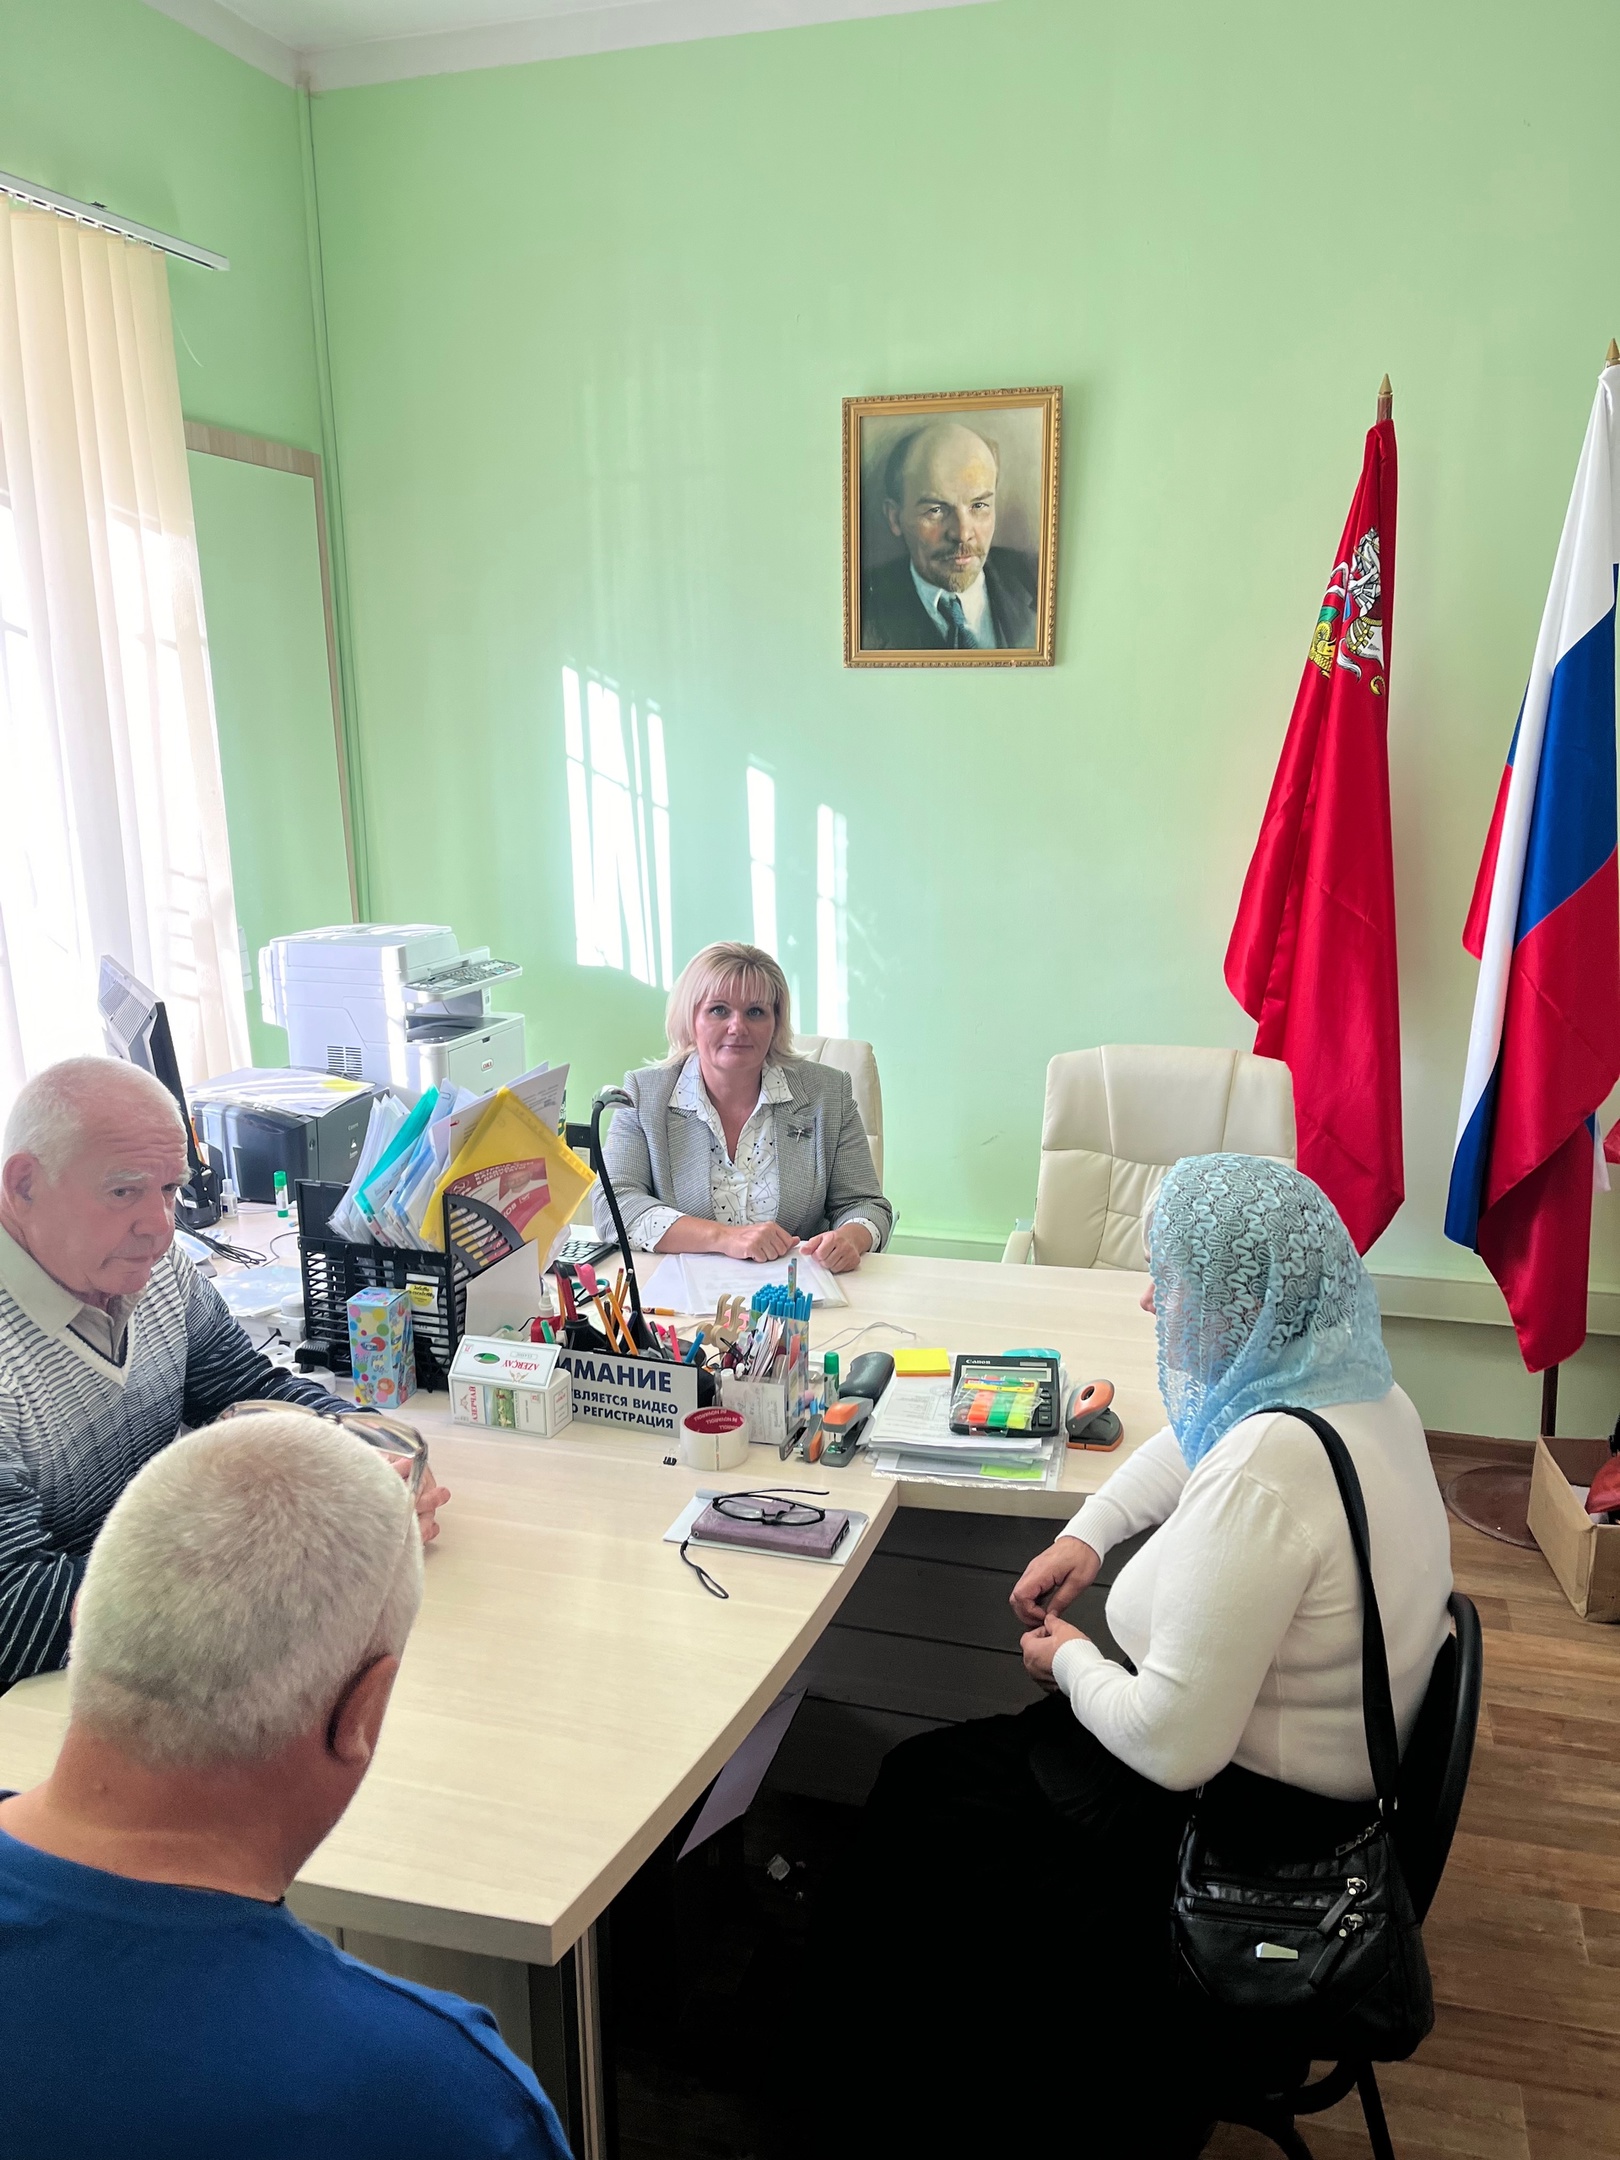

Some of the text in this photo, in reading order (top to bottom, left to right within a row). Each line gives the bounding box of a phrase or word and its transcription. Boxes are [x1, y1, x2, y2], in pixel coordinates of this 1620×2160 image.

[501, 1359, 540, 1371] AZERÇAY
[555, 1357, 672, 1393] ИМАНИЕ
[469, 1386, 478, 1422] АЗЕРЧАЙ
[572, 1389, 628, 1407] ВЛЯЕТСЯ
[633, 1398, 678, 1415] ВИДЕО
[583, 1405, 674, 1429] РЕГИСТРАЦИЯ
